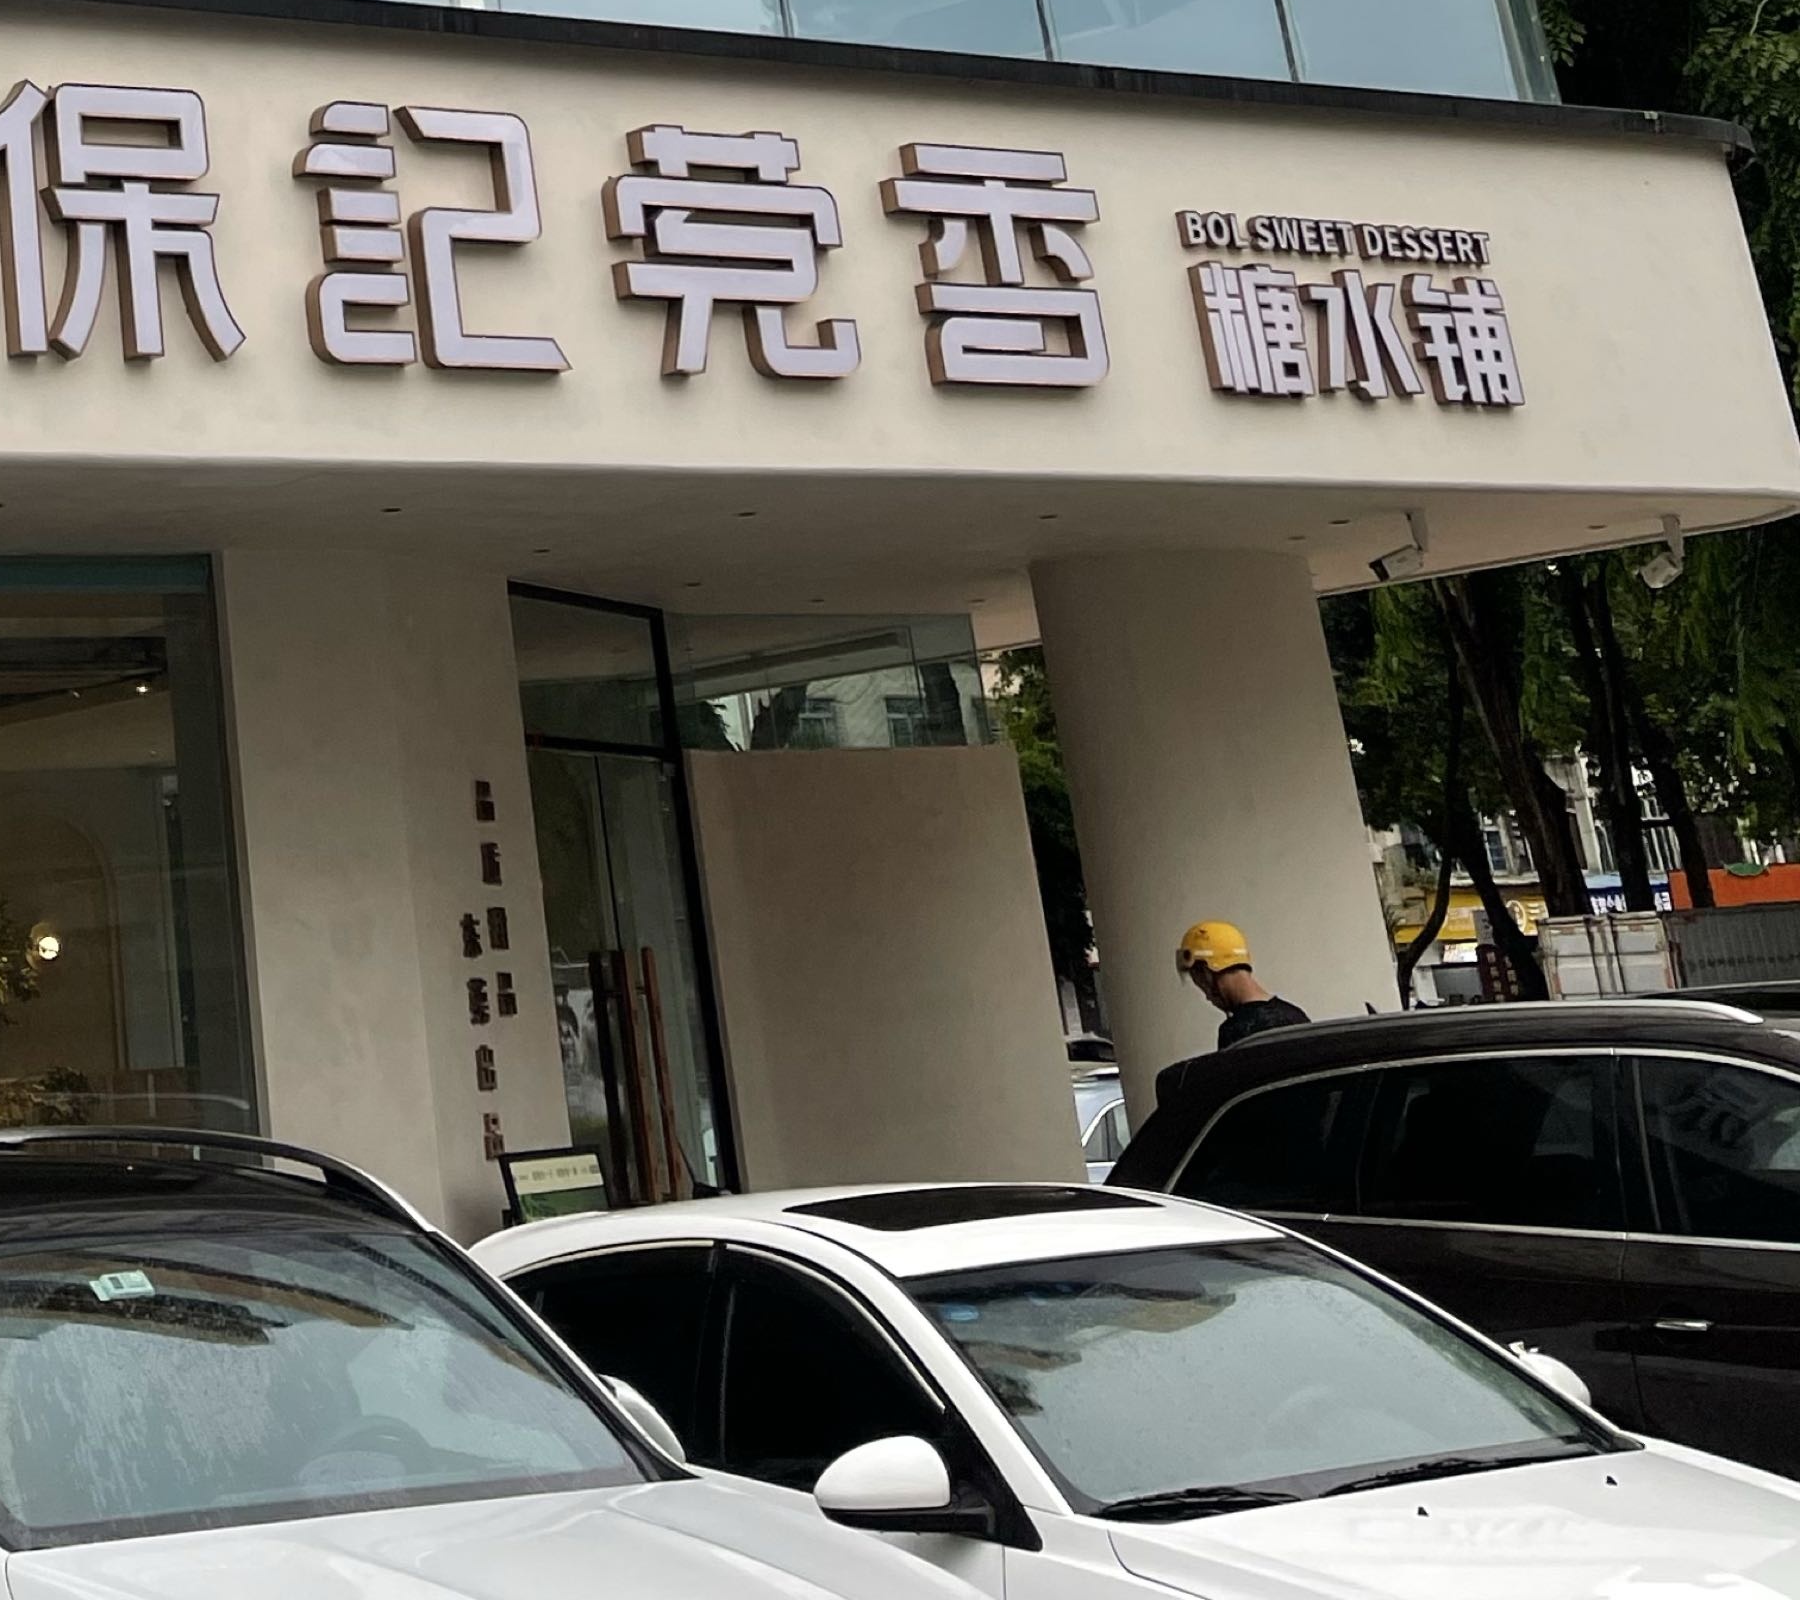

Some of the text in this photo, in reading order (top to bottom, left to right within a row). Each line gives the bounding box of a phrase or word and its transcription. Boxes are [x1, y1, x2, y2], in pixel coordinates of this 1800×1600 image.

[1177, 211, 1490, 264] BOL SWEET DESSERT
[1188, 260, 1525, 405] 糖水铺
